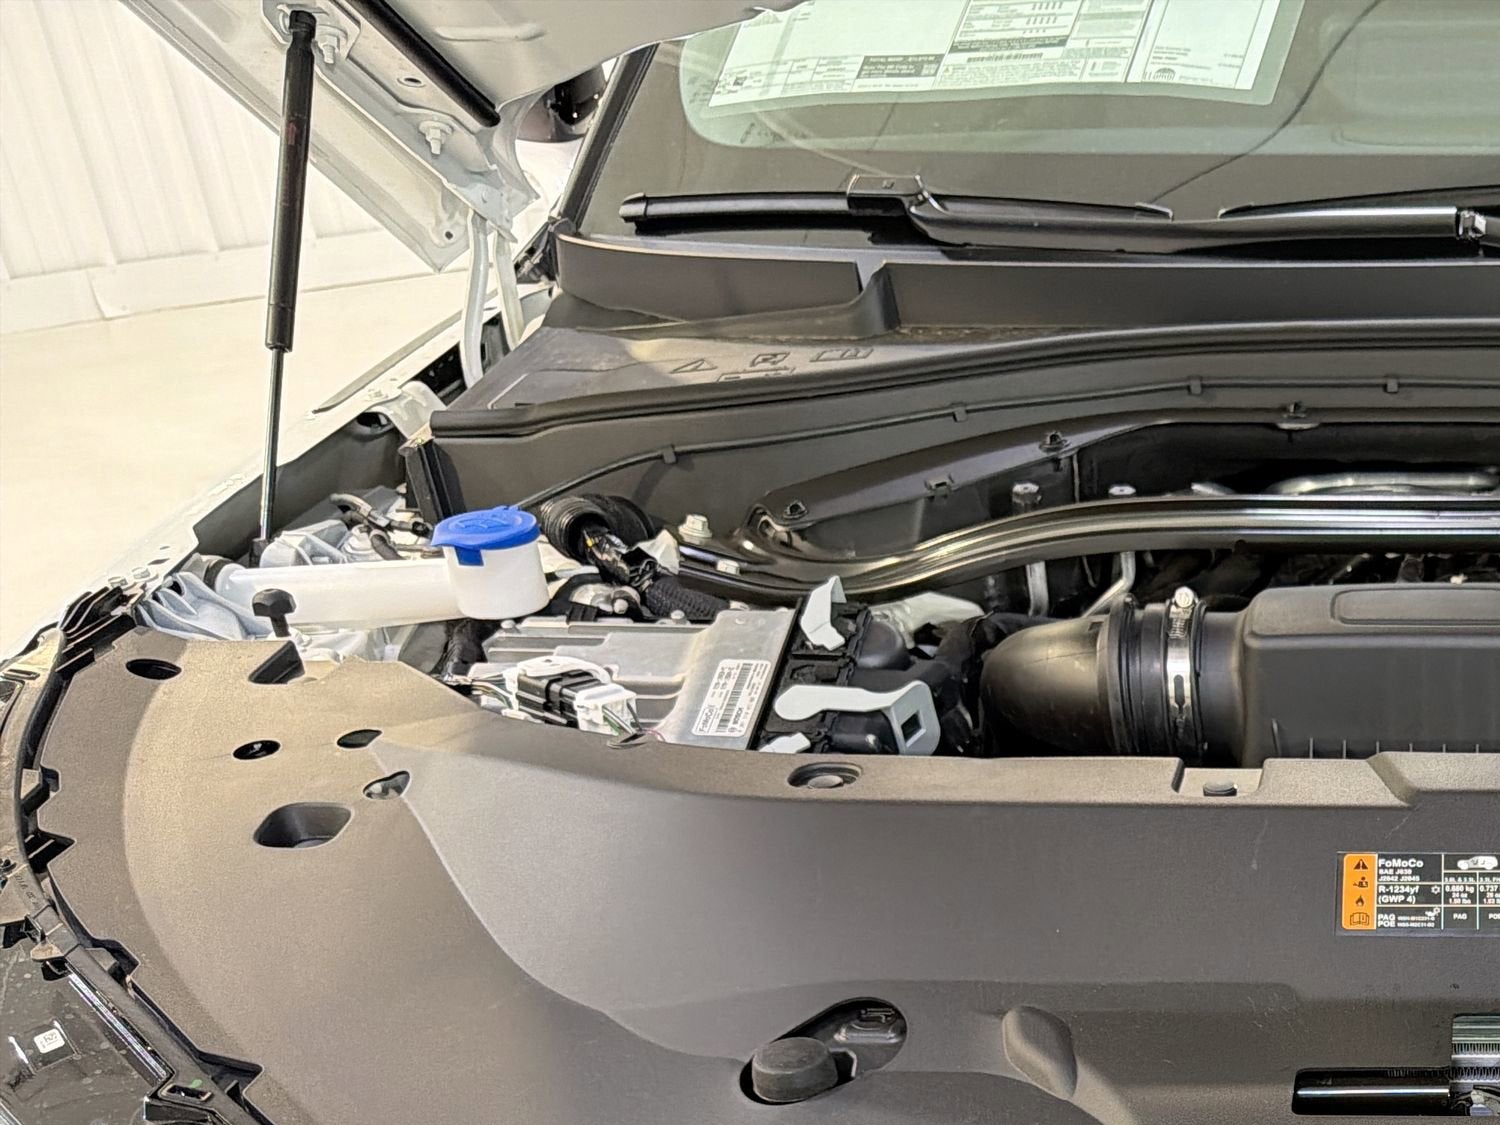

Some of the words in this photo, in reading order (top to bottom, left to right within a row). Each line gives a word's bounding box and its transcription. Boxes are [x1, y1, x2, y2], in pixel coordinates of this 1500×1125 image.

[1378, 858, 1424, 868] FoMoCo
[1378, 885, 1420, 894] R-1234yf
[1466, 885, 1474, 893] kg
[1378, 896, 1405, 904] (GWP
[1406, 896, 1416, 904] 4)
[1378, 913, 1396, 921] PAG
